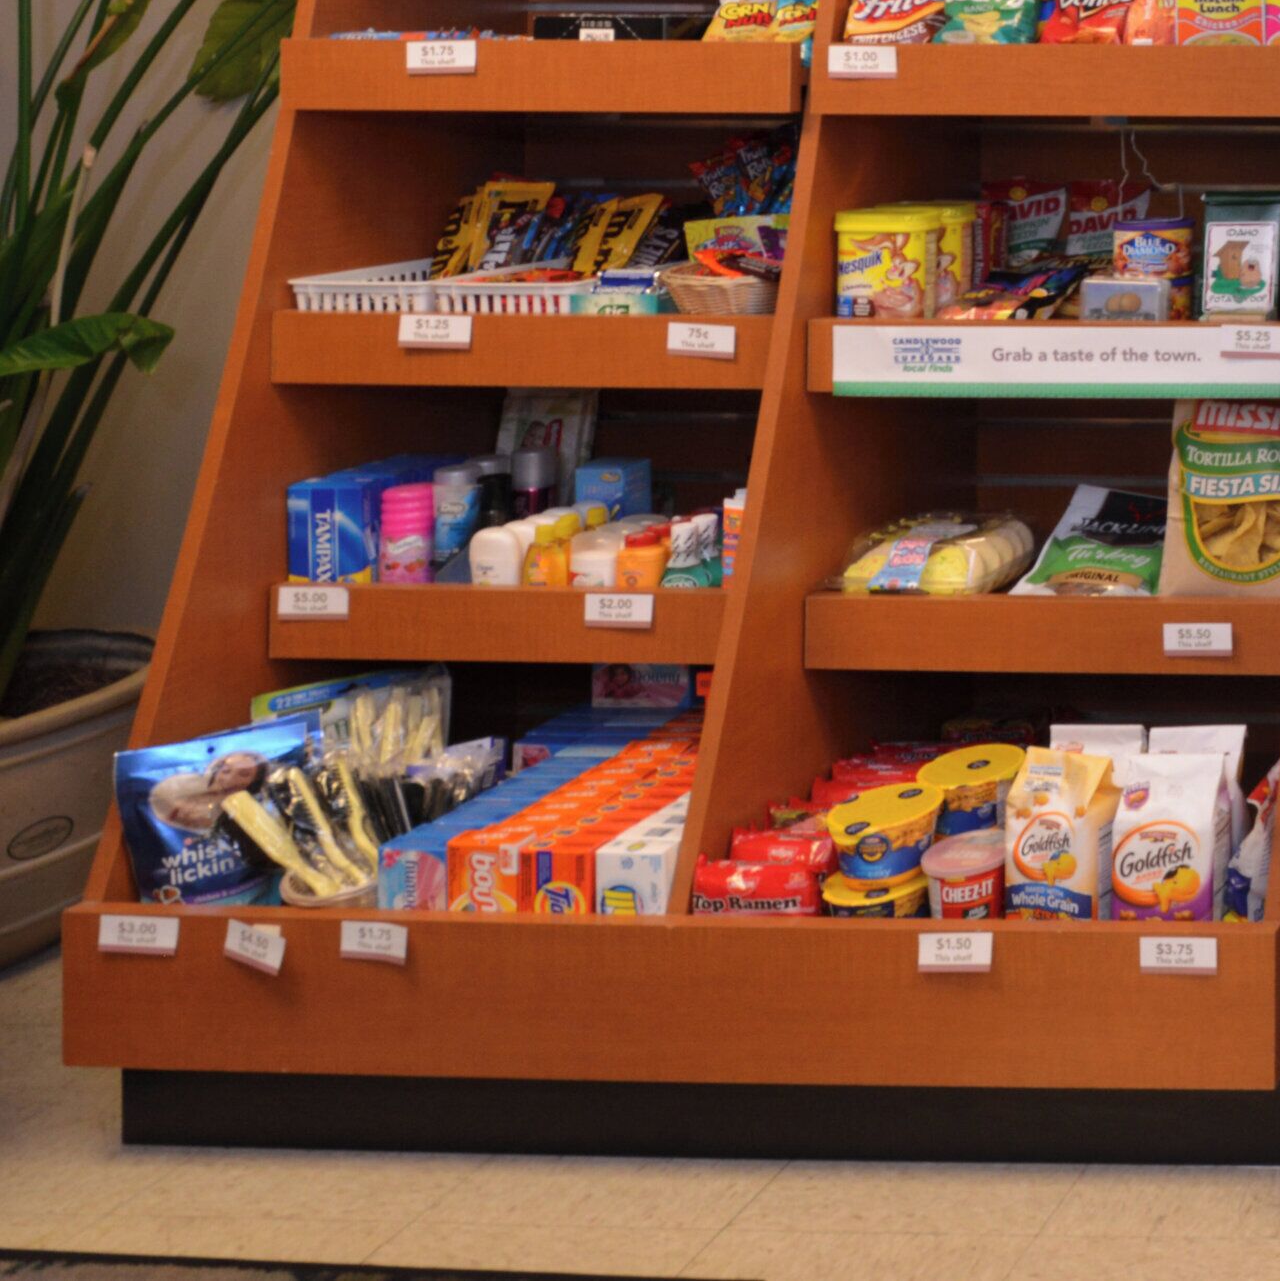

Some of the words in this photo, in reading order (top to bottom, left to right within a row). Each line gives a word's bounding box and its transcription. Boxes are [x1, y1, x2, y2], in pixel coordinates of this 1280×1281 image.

[1200, 3, 1240, 13] Lunch
[421, 45, 454, 57] $1.75
[844, 51, 878, 63] $1.00
[1235, 331, 1271, 342] $5.25
[992, 347, 1032, 362] Grab
[1039, 352, 1048, 362] a
[1054, 349, 1094, 362] taste
[1100, 347, 1117, 362] of
[1121, 347, 1149, 362] the
[1155, 349, 1201, 362] town.
[903, 363, 926, 373] local
[928, 363, 953, 373] finds
[1186, 445, 1251, 466] TORTILLA
[1190, 477, 1255, 496] FIESTA
[599, 599, 632, 610] $2.00
[1020, 833, 1070, 857] Goldfish
[1119, 845, 1194, 876] Goldfish
[941, 877, 994, 903] CHEEZ-IT
[693, 895, 728, 913] Top
[732, 895, 798, 912] Ramen
[1011, 893, 1048, 910] Whole
[1050, 897, 1080, 915] Grain
[118, 921, 156, 935] $3.00
[358, 927, 392, 941] $1.75
[936, 937, 971, 951] $1.50
[1156, 943, 1193, 956] $3.75
